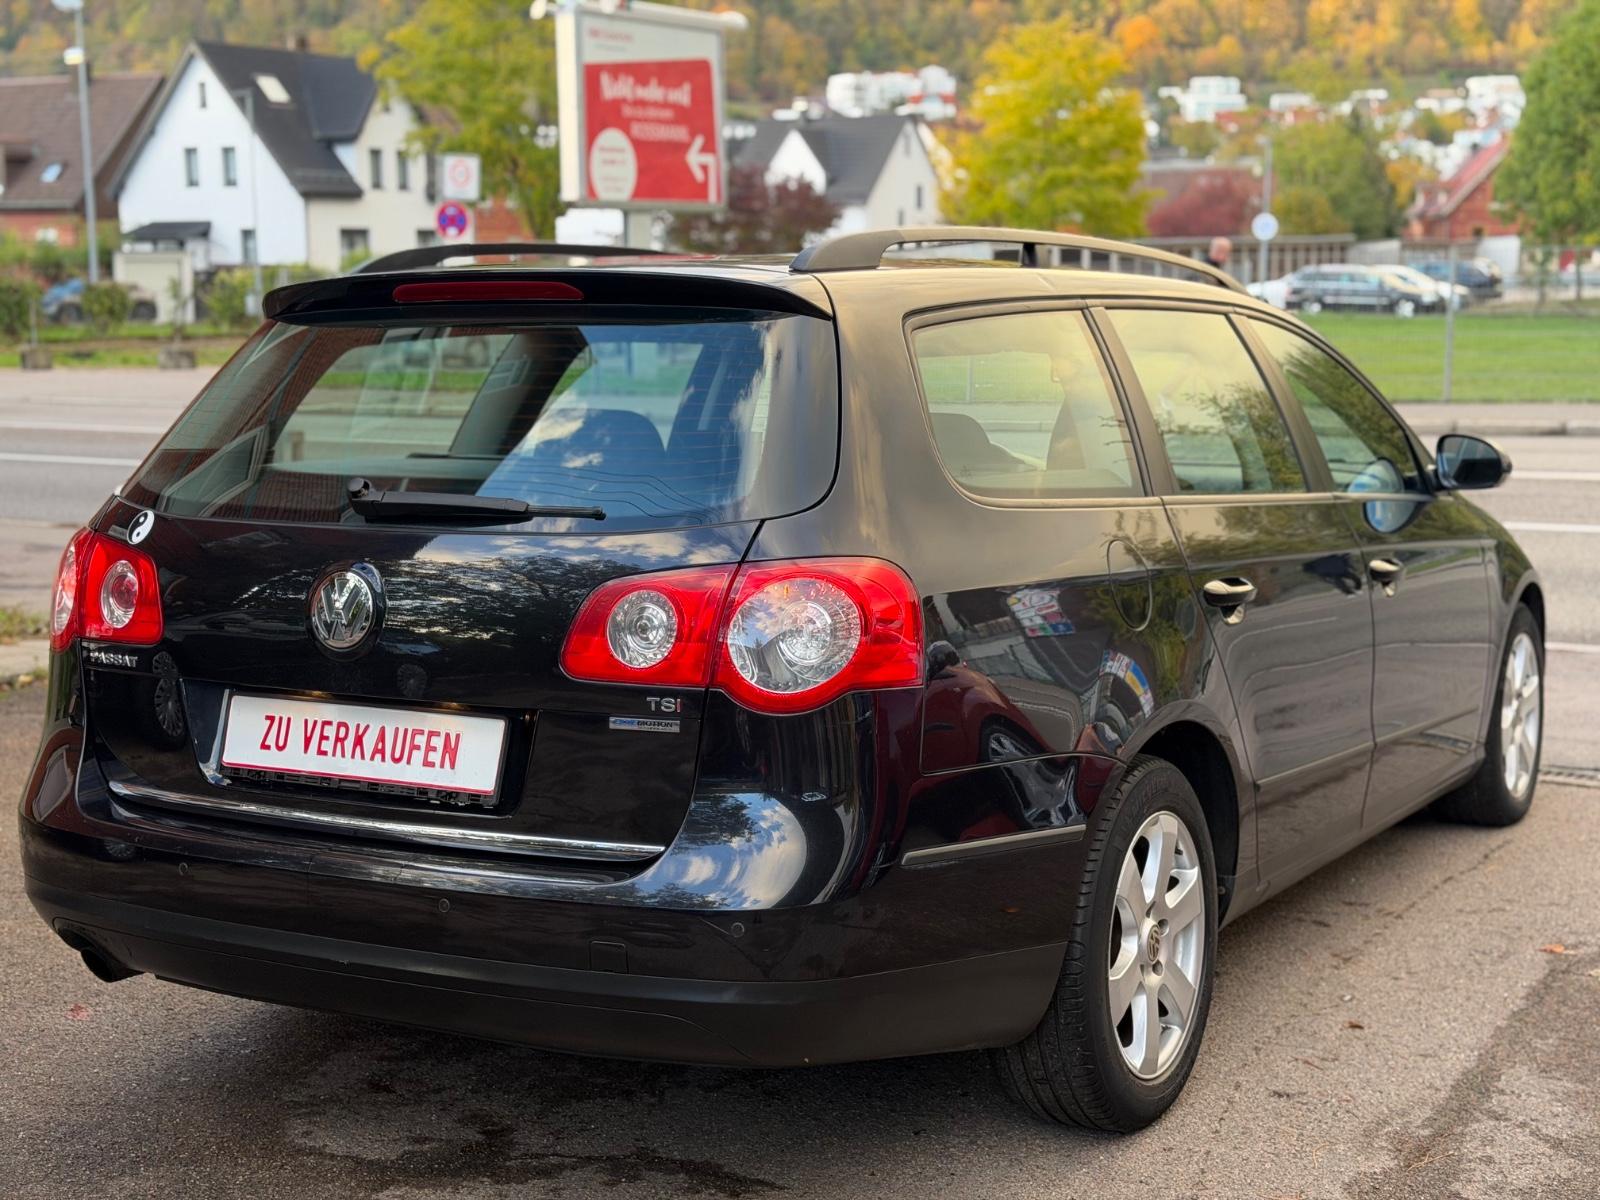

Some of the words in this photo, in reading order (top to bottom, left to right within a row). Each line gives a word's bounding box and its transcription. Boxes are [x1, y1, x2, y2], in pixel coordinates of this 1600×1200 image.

[90, 651, 138, 668] PASSAT
[646, 697, 681, 713] TSI
[260, 715, 292, 752] ZU
[303, 718, 461, 770] VERKAUFEN
